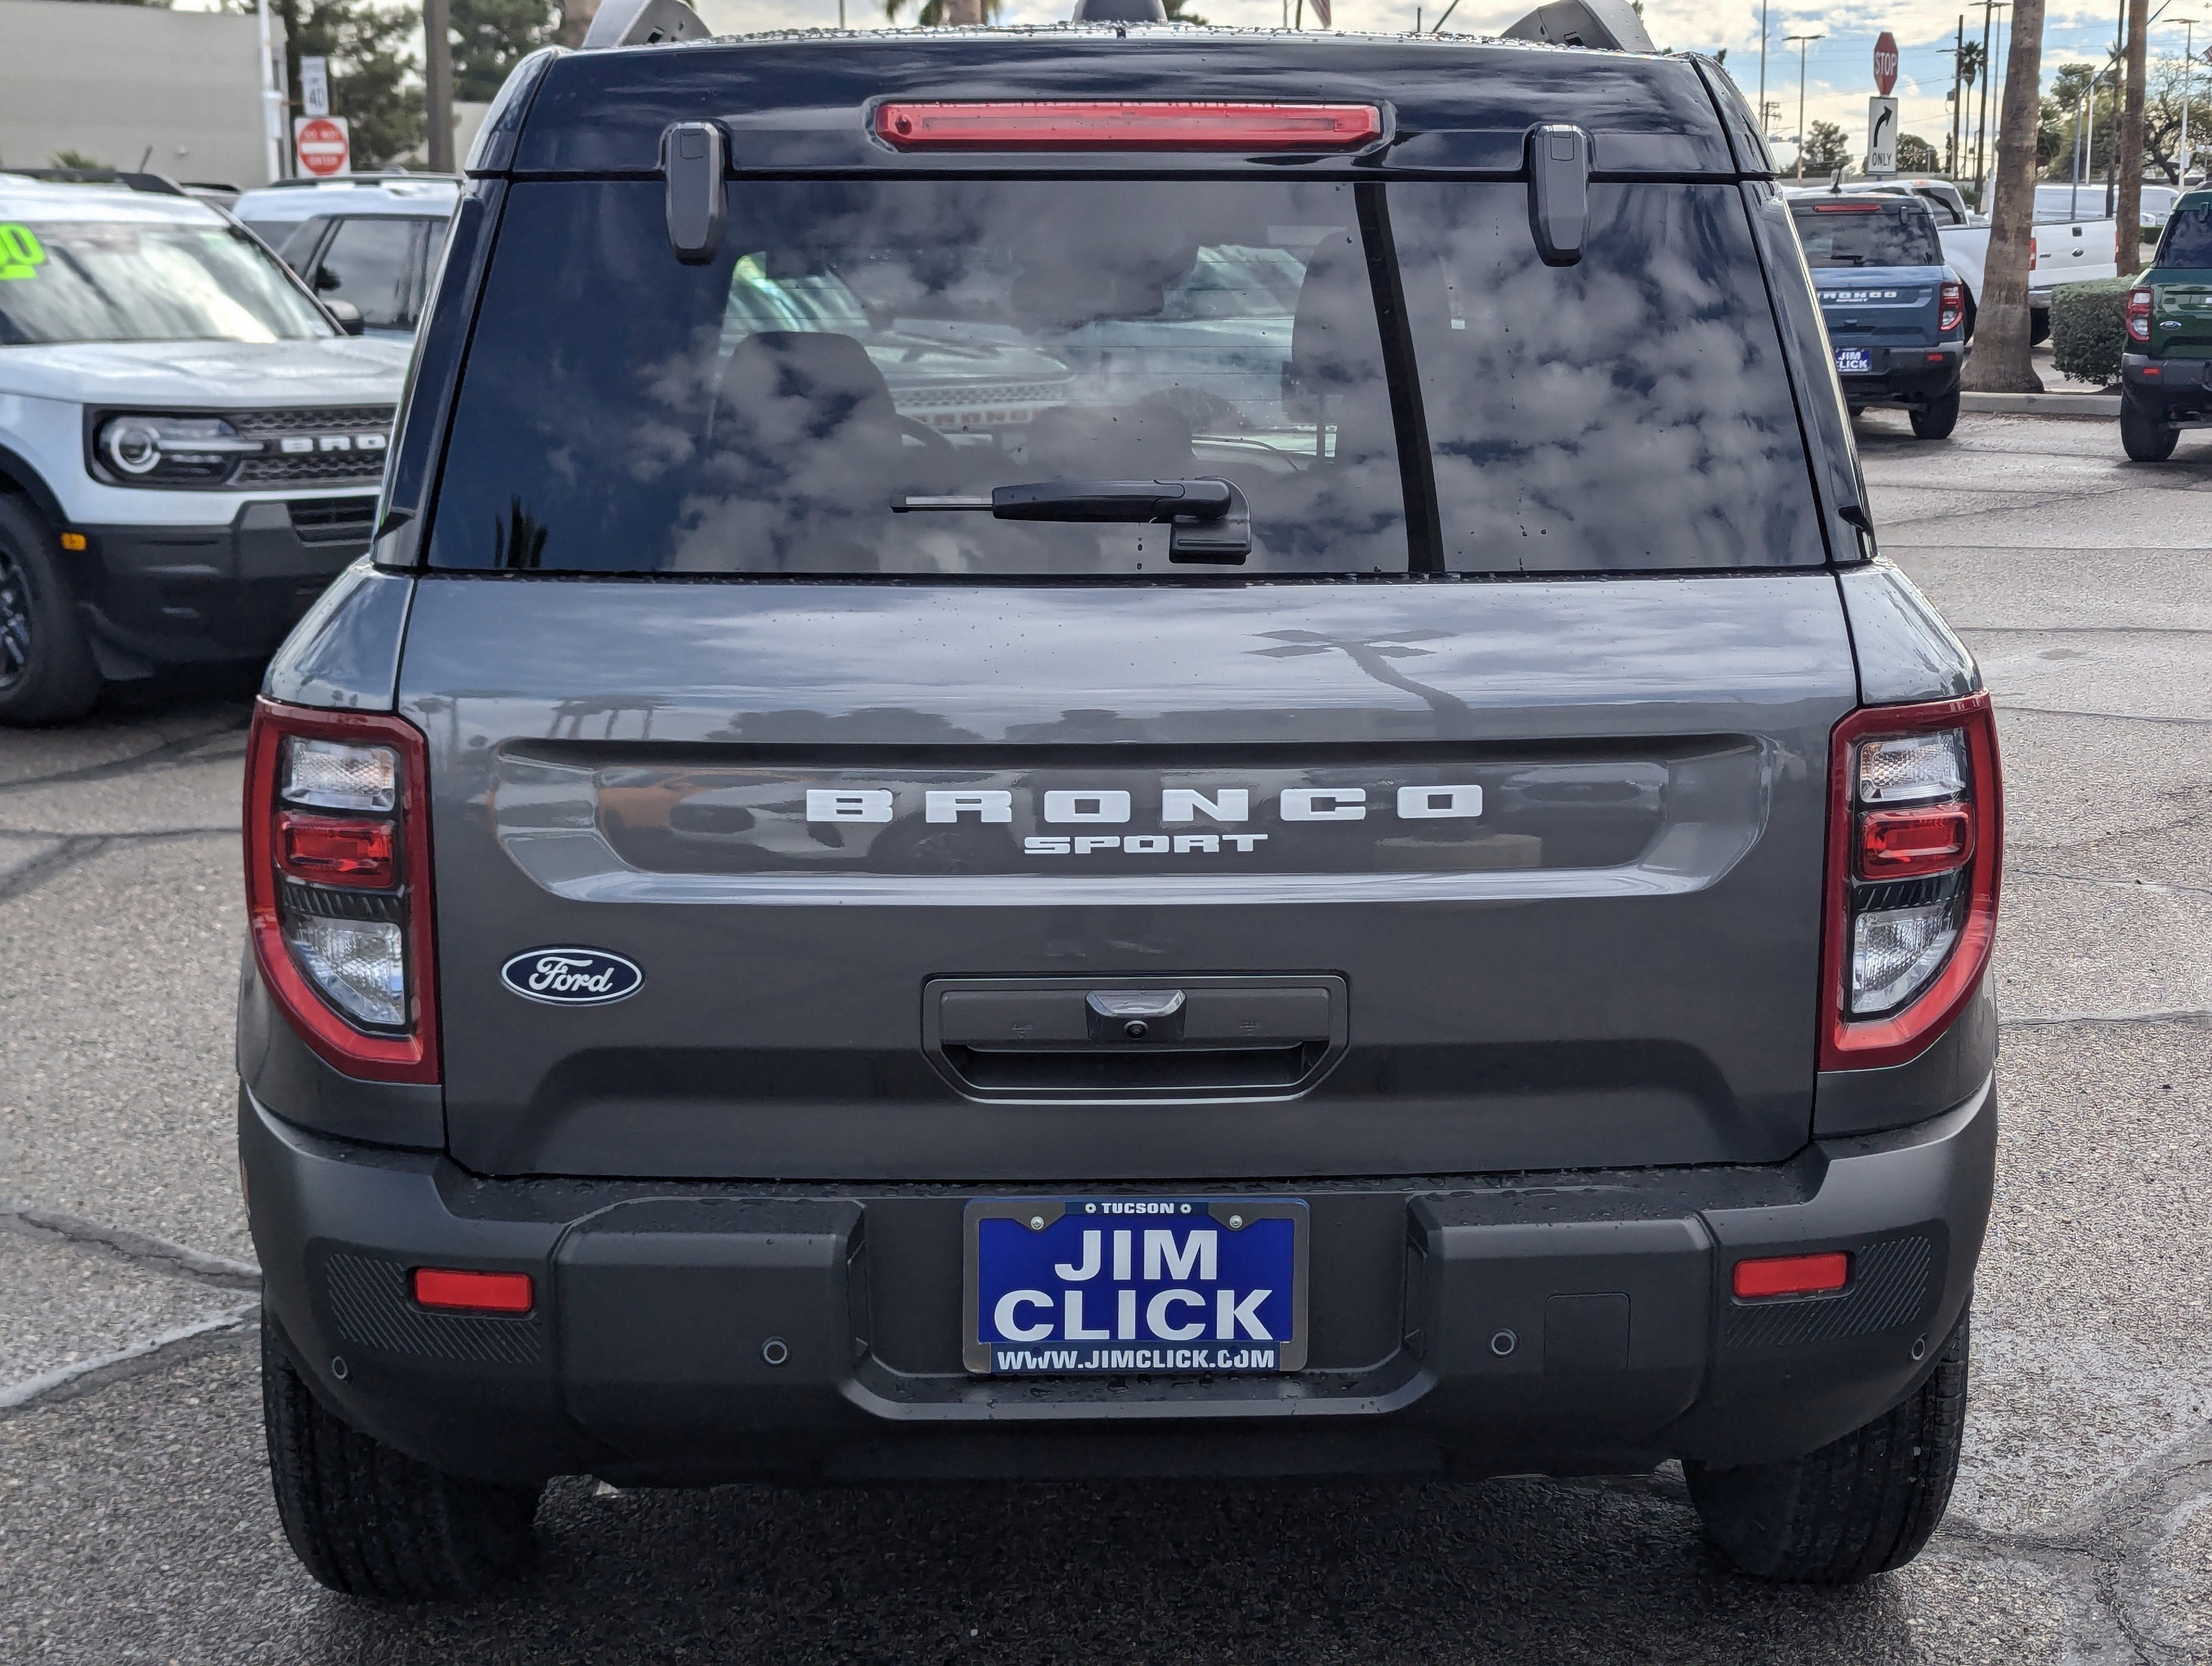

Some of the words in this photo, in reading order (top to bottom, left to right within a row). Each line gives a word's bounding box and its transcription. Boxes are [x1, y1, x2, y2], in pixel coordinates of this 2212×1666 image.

[1875, 52, 1897, 76] STOP
[1872, 152, 1892, 166] ONLY
[1838, 351, 1861, 360] JIM
[806, 784, 1483, 823] BRONCO
[1024, 834, 1269, 855] SPORT
[528, 956, 615, 992] Ford
[1101, 1202, 1174, 1214] TUCSON
[1054, 1229, 1218, 1281] JIM
[994, 1289, 1274, 1342] CLICK
[997, 1349, 1275, 1370] WWW.JIMCLICK.COM
